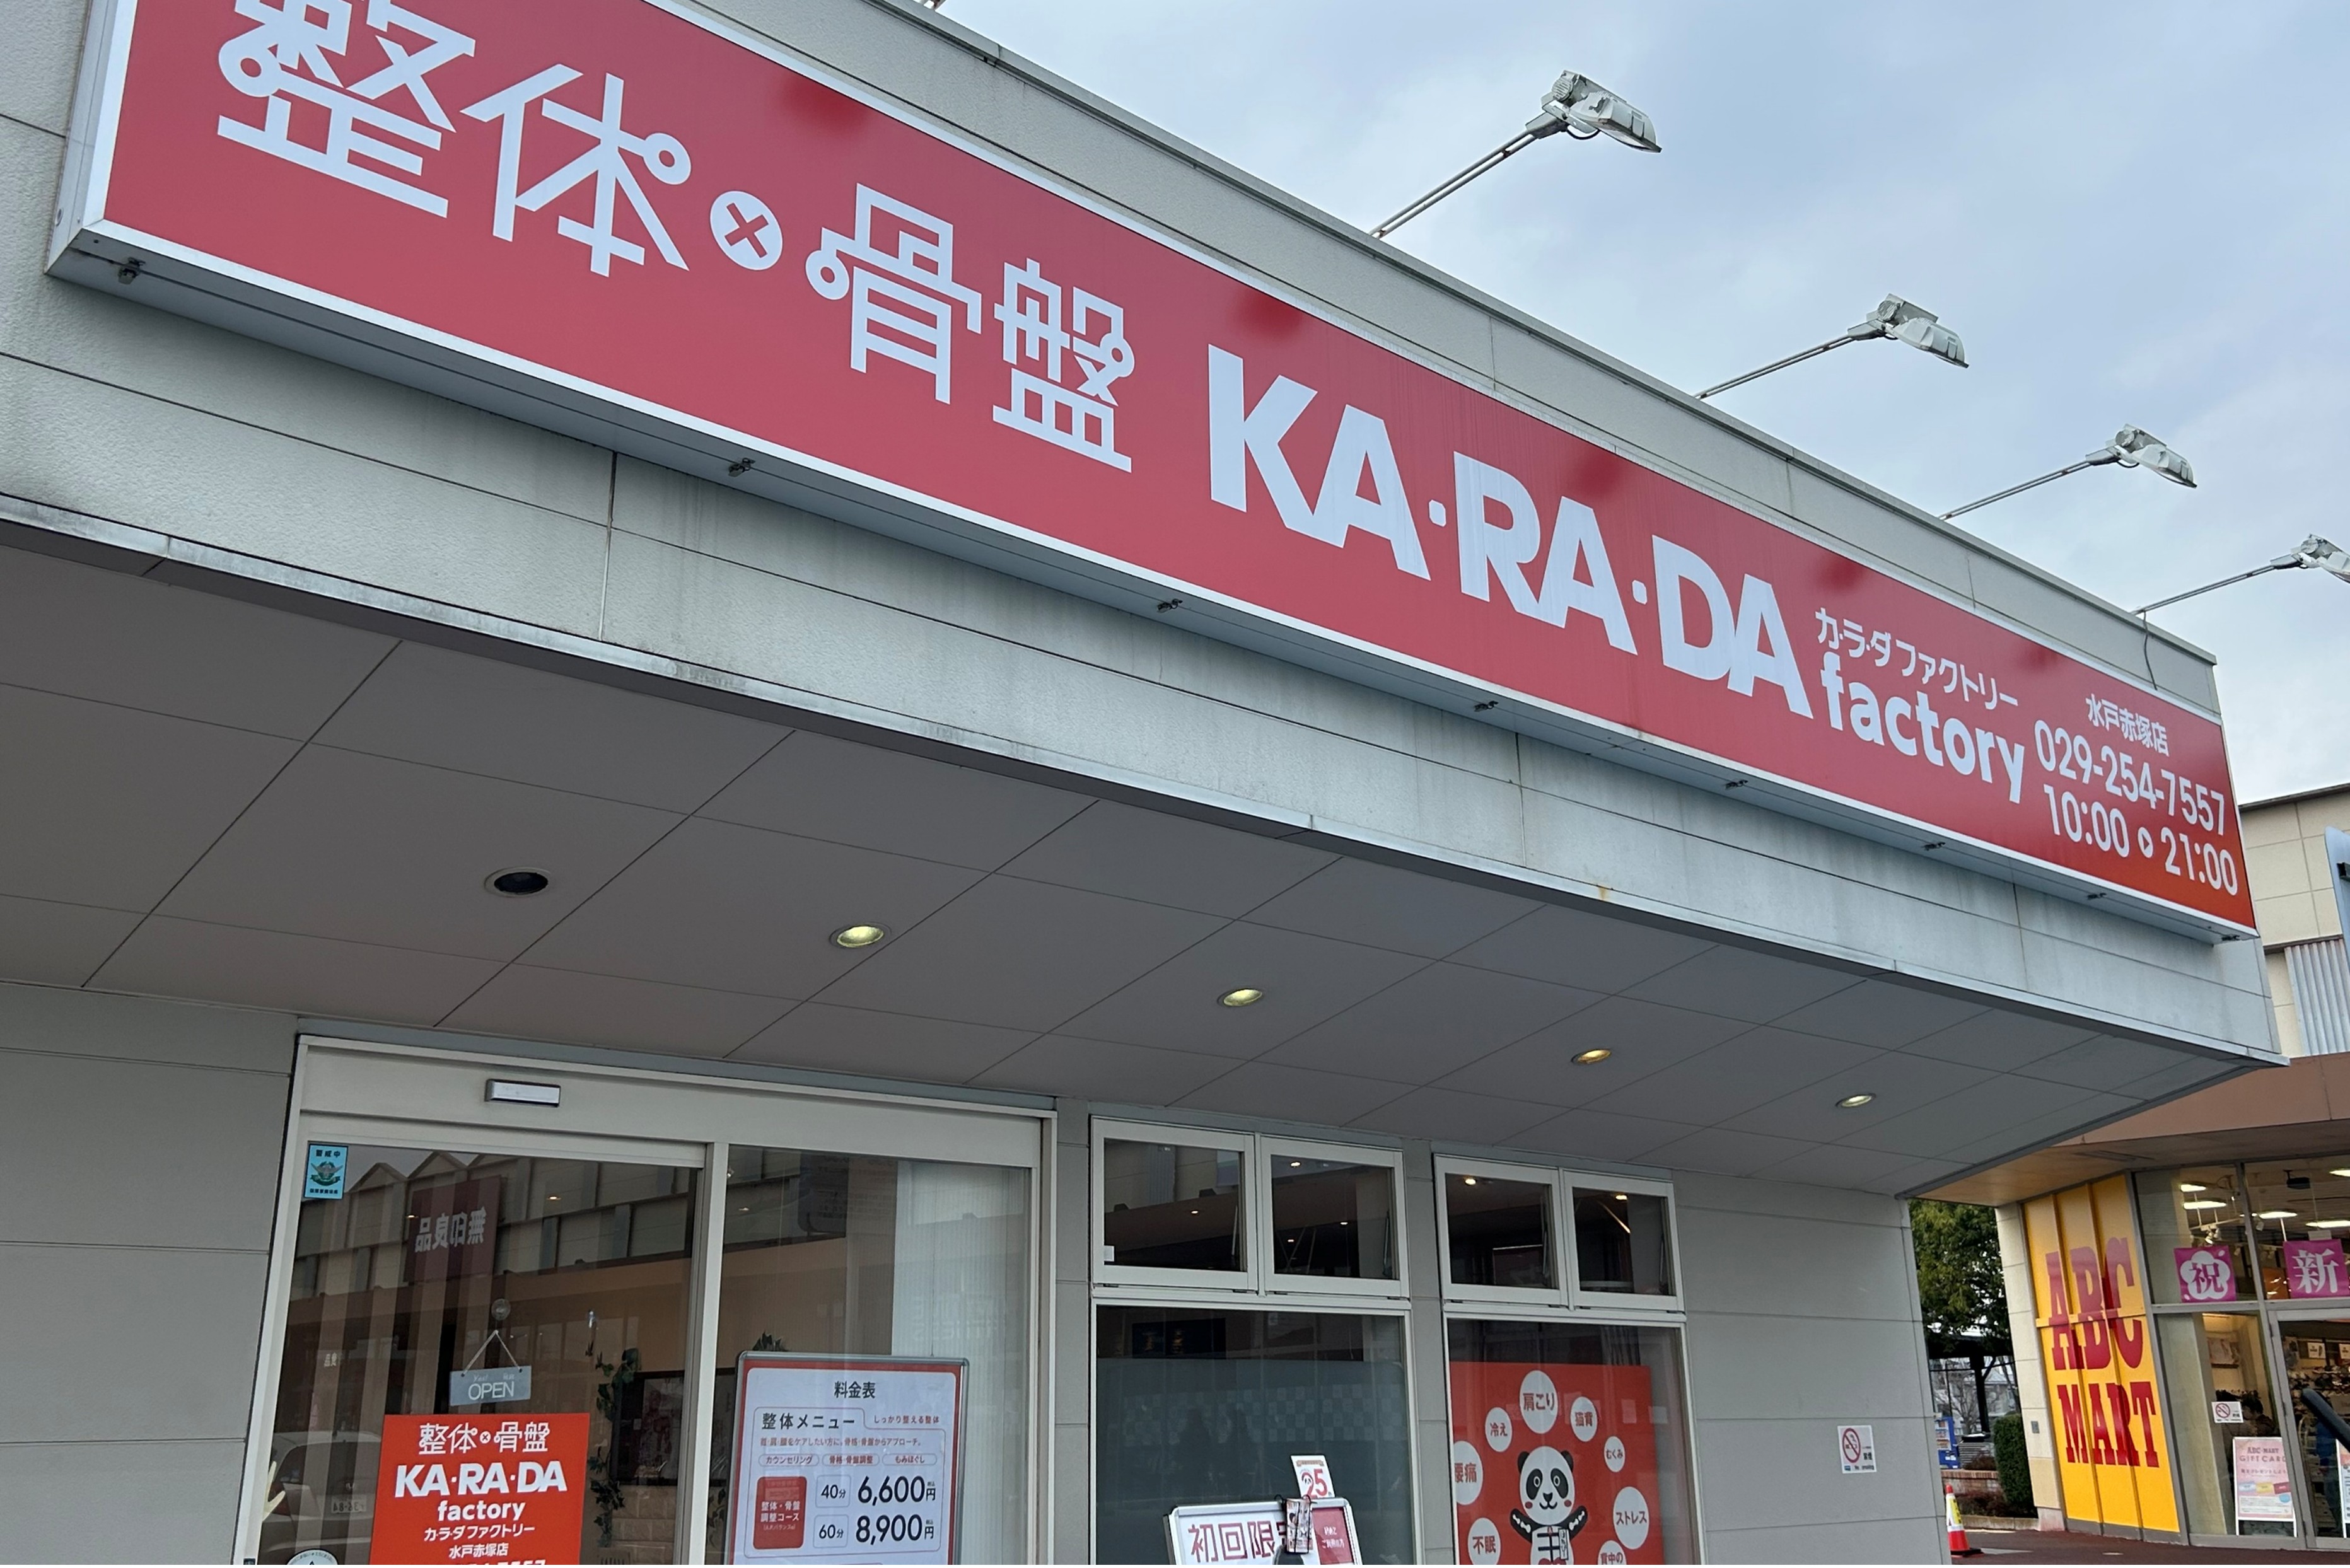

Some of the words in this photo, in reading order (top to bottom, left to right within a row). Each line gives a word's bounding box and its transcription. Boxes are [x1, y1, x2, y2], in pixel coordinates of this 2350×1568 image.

[1820, 651, 2025, 804] factory
[2085, 694, 2170, 757] 水戸赤塚店
[2034, 719, 2225, 836] 029-254-7557
[2043, 784, 2129, 858] 10:00
[2160, 829, 2238, 895] 21:00
[2189, 1262, 2224, 1293] 祝
[2292, 1248, 2339, 1293] 新
[2045, 1237, 2143, 1370] ABC
[468, 1381, 515, 1400] OPEN
[834, 1381, 876, 1398] 料金表
[1523, 1393, 1554, 1411] 肩こり
[762, 1412, 854, 1430] 整体メニュー
[1490, 1422, 1508, 1437] 冷え
[1574, 1412, 1593, 1427] 猫背
[2057, 1381, 2159, 1467] MART
[766, 1456, 813, 1464] カウンセリング
[1605, 1449, 1624, 1459] むくみ
[821, 1484, 846, 1499] 40分
[858, 1475, 936, 1506] 6,600円
[438, 1500, 525, 1521] factory
[1615, 1511, 1647, 1525] ストレス
[819, 1524, 844, 1539] 60分
[856, 1514, 934, 1545] 8,900円
[449, 1542, 509, 1559] 水戸赤塚店
[1188, 1521, 1286, 1562] 初回限
[1473, 1536, 1496, 1554] 不眠
